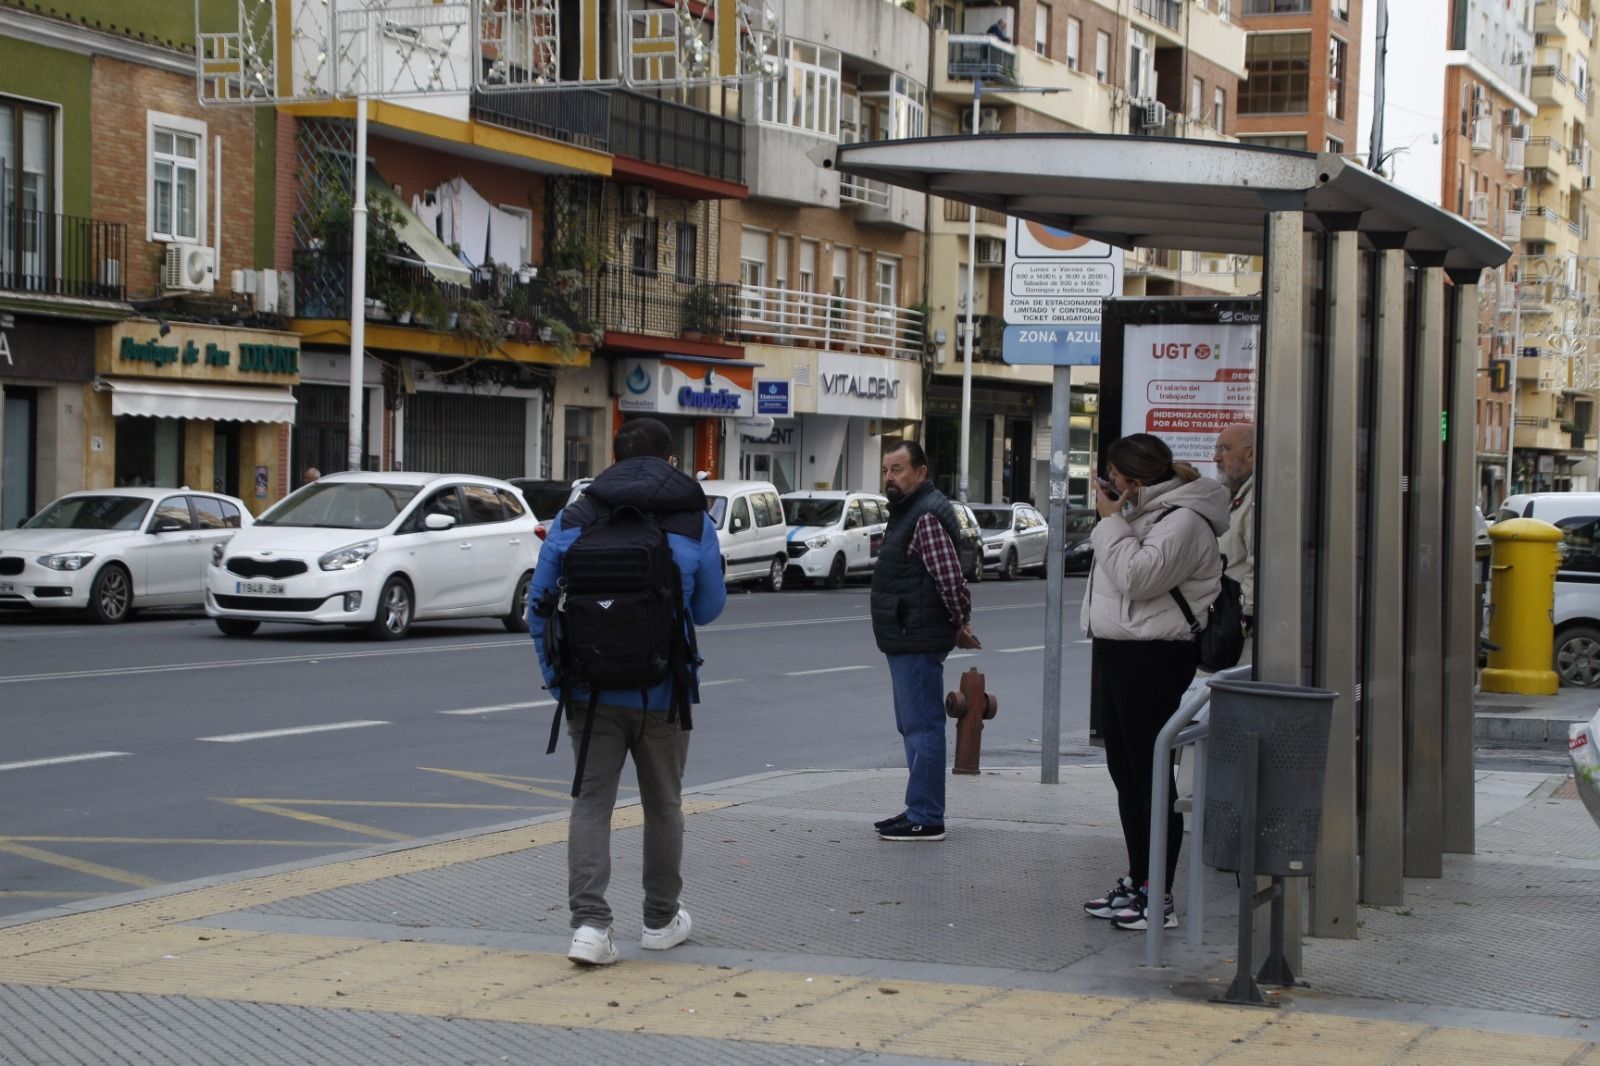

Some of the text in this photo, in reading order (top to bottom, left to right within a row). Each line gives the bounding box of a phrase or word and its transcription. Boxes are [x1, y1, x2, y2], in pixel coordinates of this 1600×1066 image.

[1234, 312, 1260, 321] Clear
[1019, 331, 1101, 343] ZONA AZUL
[120, 336, 179, 367] Boutique
[182, 340, 200, 364] de
[1152, 343, 1191, 359] UGT
[822, 373, 900, 400] VITALDENT
[1160, 394, 1196, 402] trabajador
[1154, 411, 1218, 420] INDEMNIZACIÓN
[1172, 419, 1190, 428] AÑO
